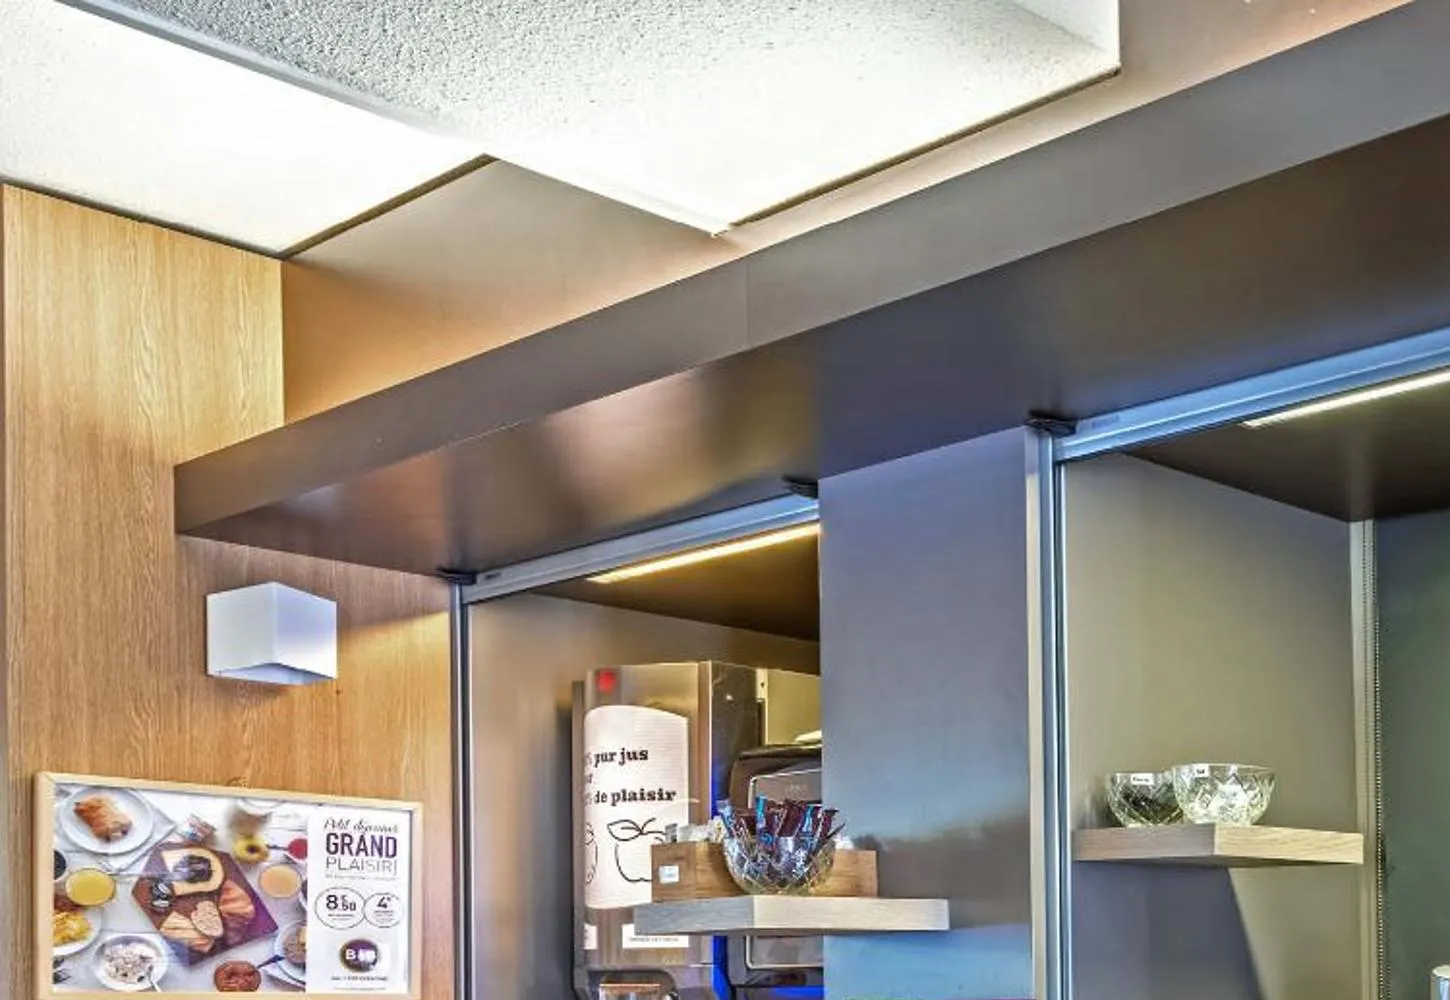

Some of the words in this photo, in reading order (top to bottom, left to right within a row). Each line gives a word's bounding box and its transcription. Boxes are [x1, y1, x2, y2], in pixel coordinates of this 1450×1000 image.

[619, 747, 649, 766] jus
[611, 788, 677, 807] plaisir
[326, 832, 397, 859] GRAND
